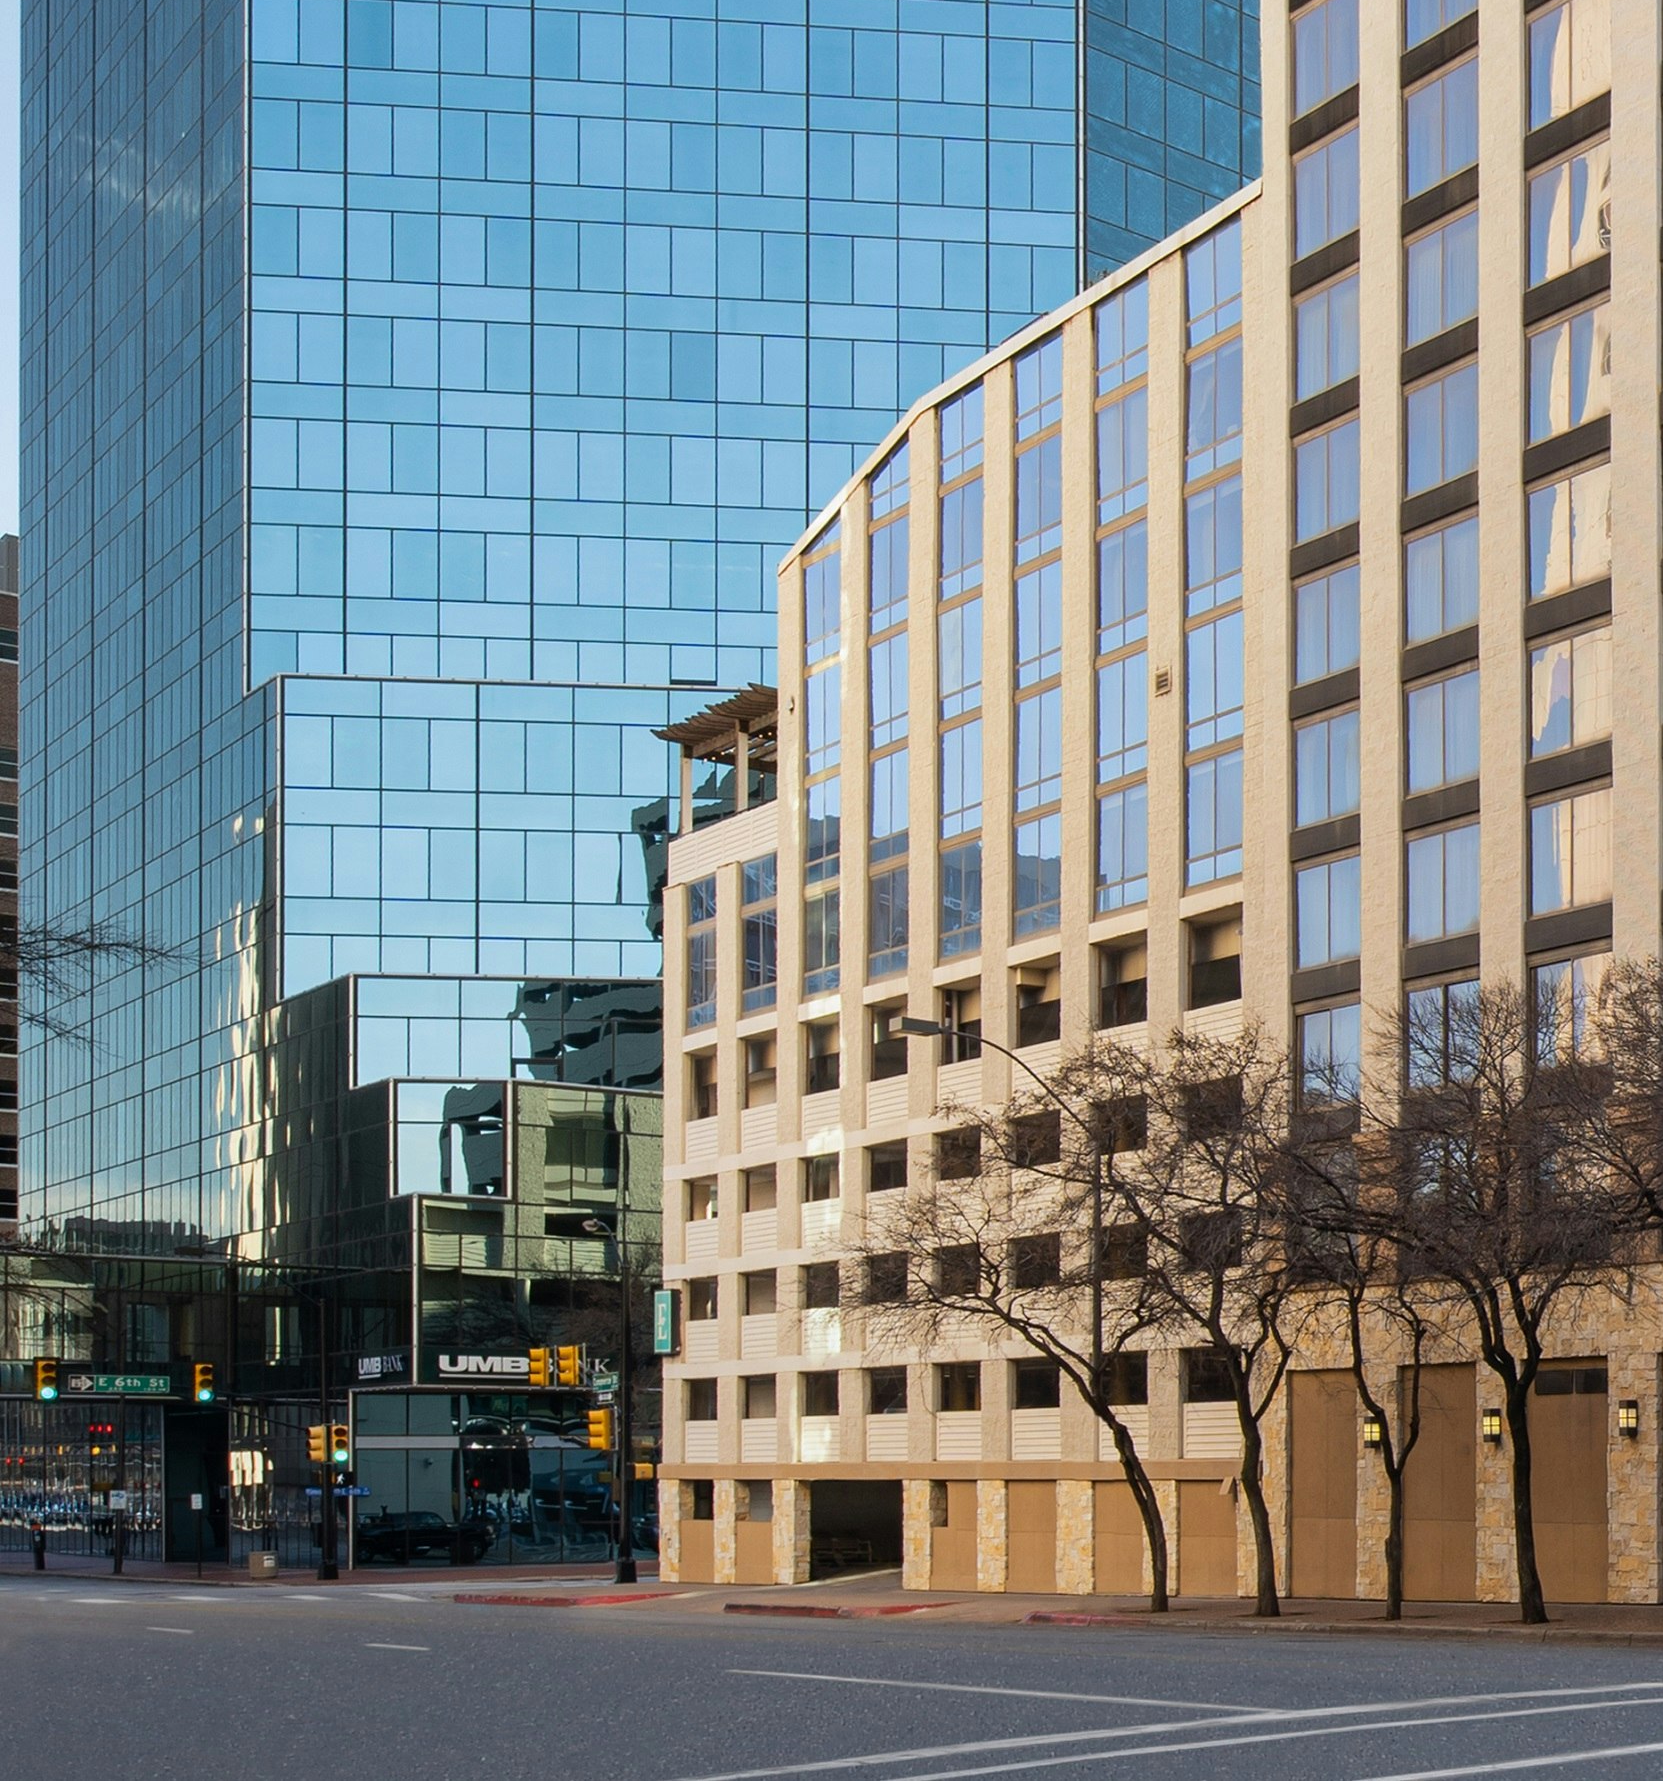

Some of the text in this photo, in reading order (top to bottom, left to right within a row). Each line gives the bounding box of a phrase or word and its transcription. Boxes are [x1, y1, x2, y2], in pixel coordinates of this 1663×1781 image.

[358, 1355, 403, 1374] UMB BANK
[439, 1355, 529, 1373] UMB
[98, 1378, 107, 1387] E
[115, 1377, 141, 1387] 6th
[149, 1378, 164, 1388] St
